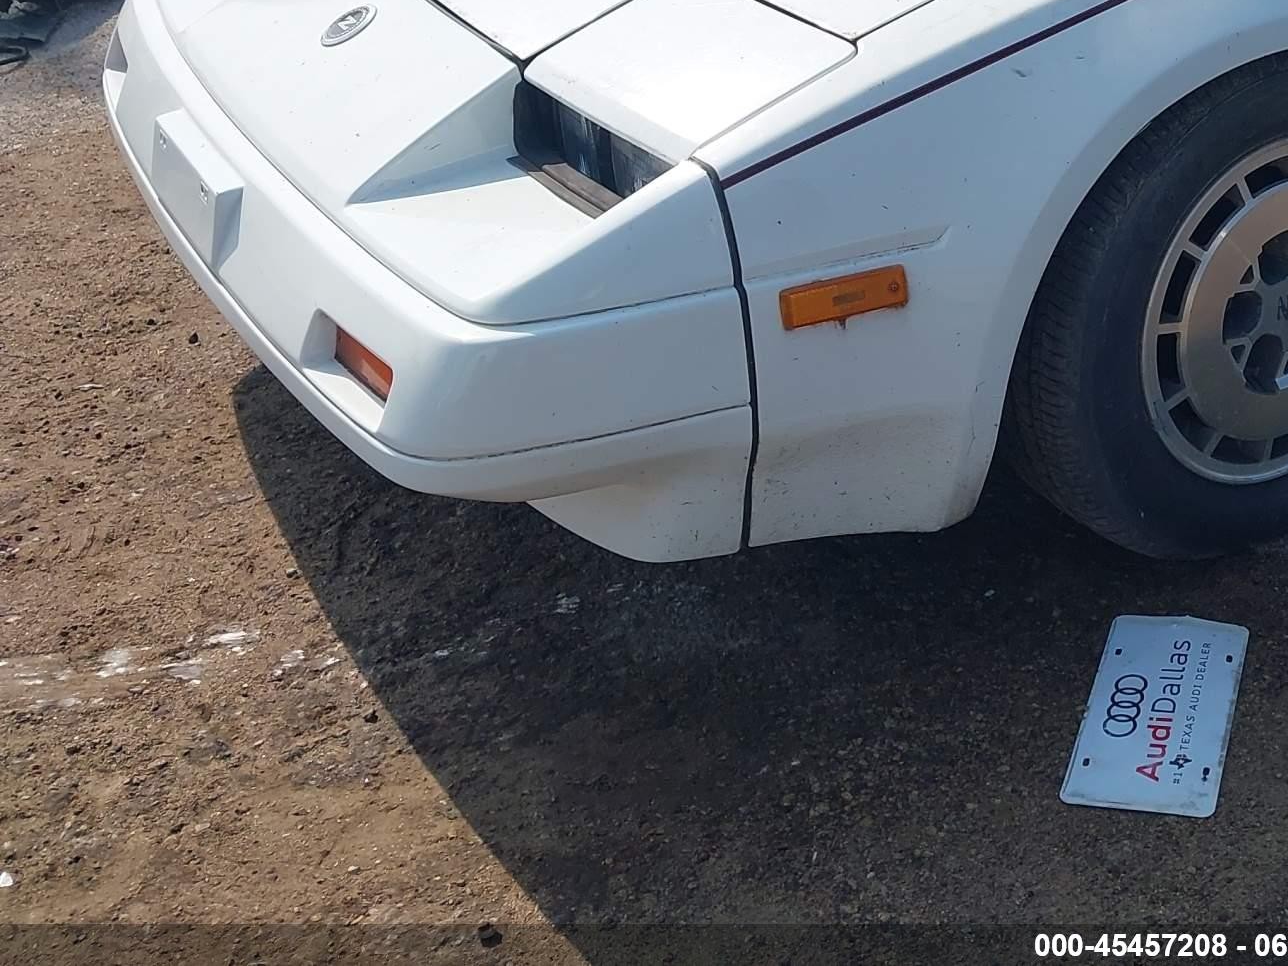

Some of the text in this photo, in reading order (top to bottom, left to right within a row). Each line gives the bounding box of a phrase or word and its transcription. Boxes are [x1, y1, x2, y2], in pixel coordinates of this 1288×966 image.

[1195, 642, 1212, 681] DEALER
[1189, 684, 1202, 712] AUDI
[1179, 715, 1196, 751] TEXAS
